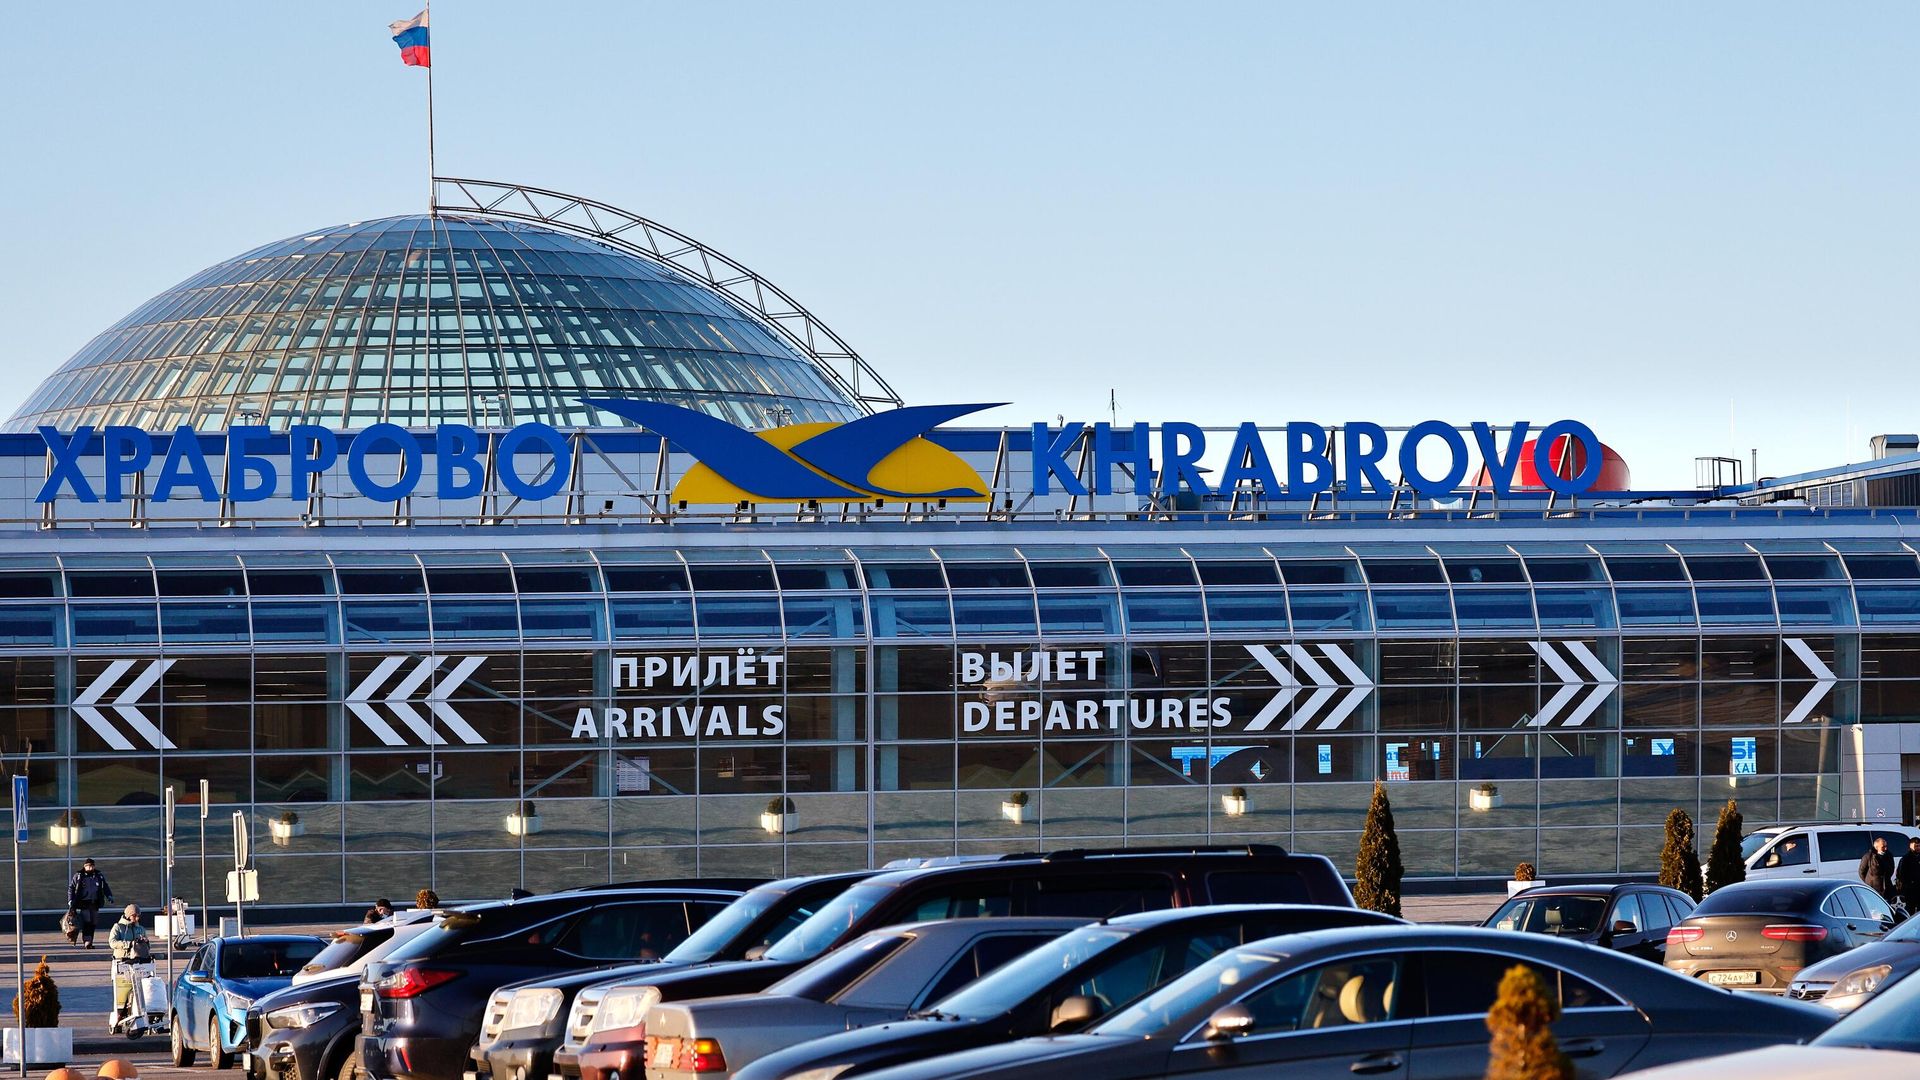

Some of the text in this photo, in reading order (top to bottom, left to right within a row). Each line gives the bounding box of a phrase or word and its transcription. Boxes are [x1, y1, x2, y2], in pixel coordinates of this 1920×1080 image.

[35, 422, 571, 502] ХРАБРОВО
[1031, 419, 1602, 497] KHRABROVO
[612, 647, 784, 688] ПРИЛЁТ
[961, 650, 1104, 683] ВЫЛЕТ
[571, 704, 784, 738] ARRIVALS
[963, 697, 1232, 732] DEPARTURES
